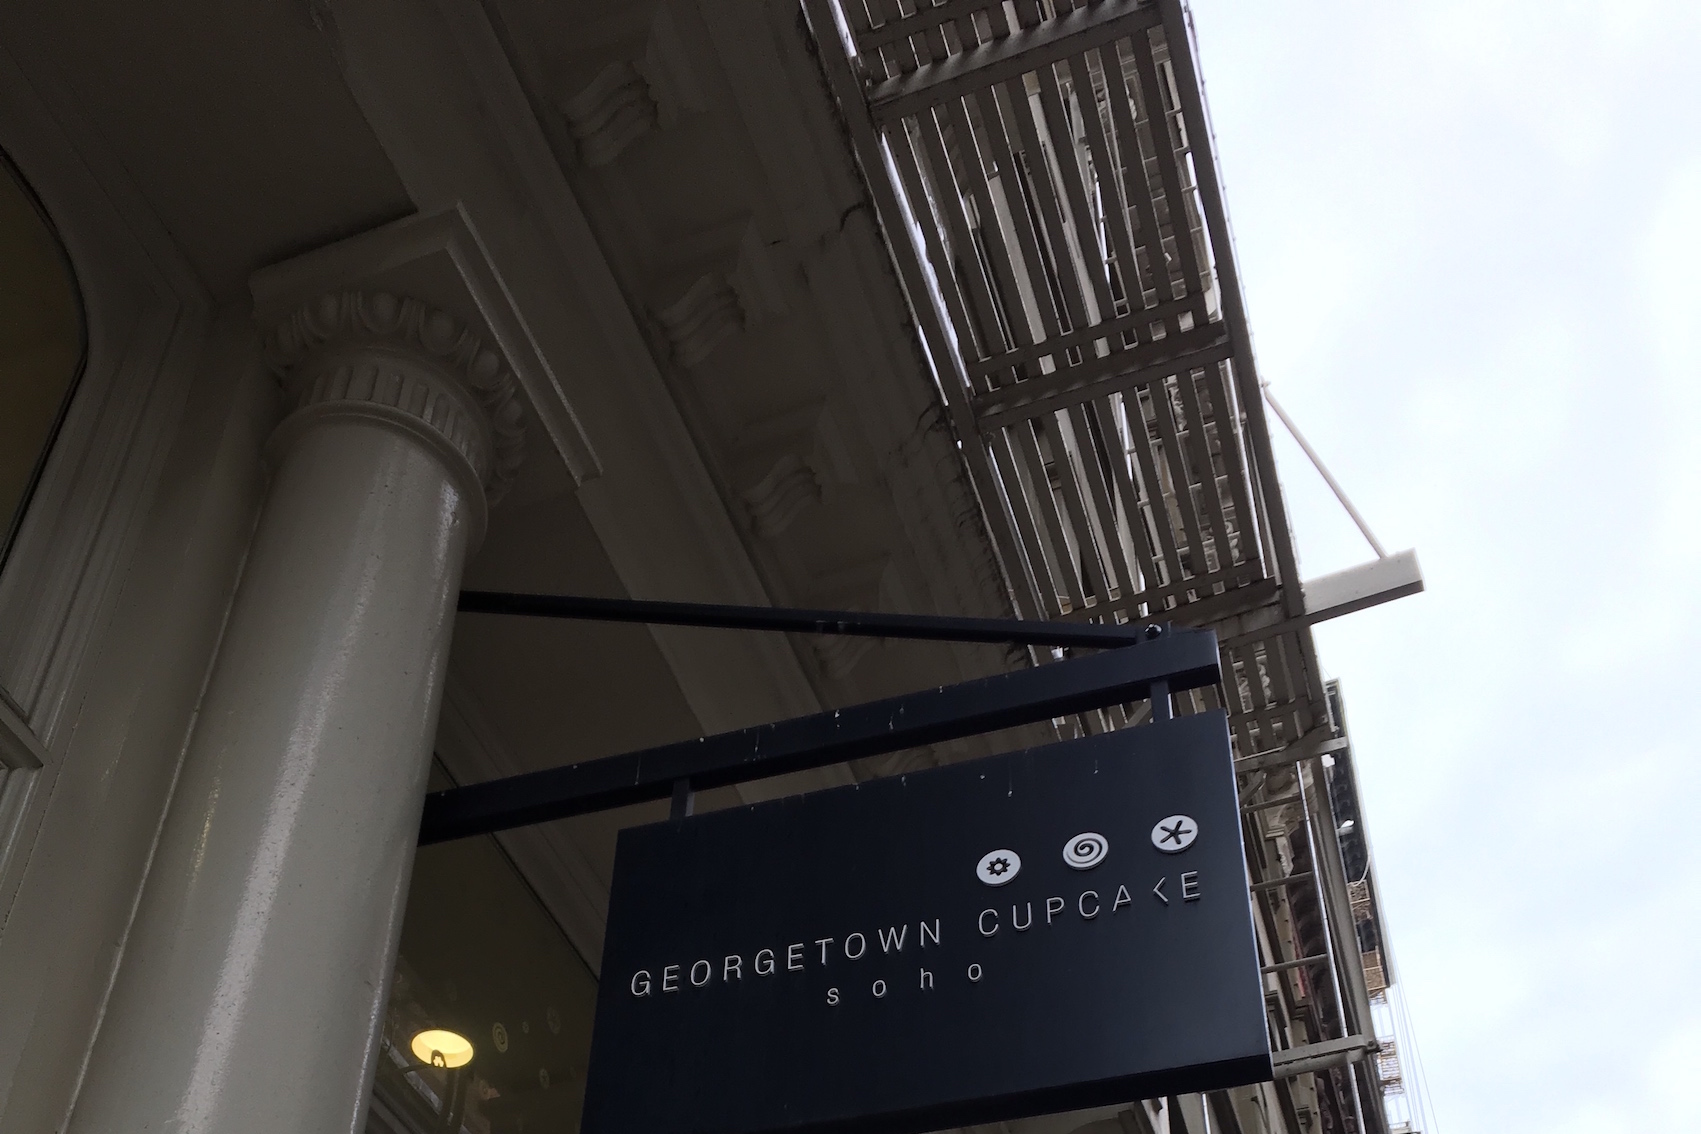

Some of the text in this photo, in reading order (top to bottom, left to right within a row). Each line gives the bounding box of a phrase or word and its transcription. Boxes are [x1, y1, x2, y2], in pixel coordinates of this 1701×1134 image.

[630, 869, 1203, 997] GEORGETOWN CUPCAKE
[826, 961, 984, 1005] soho
